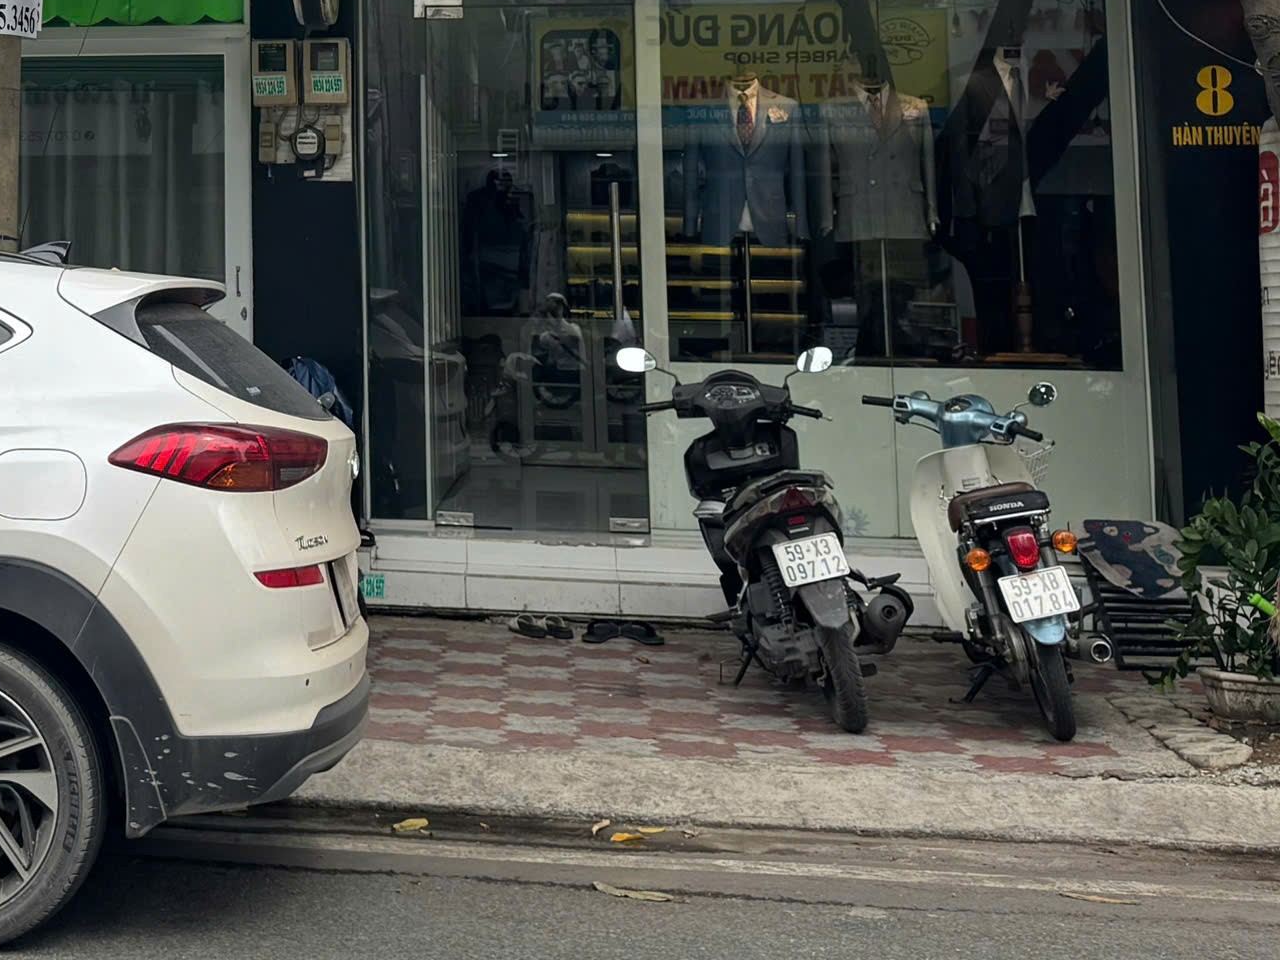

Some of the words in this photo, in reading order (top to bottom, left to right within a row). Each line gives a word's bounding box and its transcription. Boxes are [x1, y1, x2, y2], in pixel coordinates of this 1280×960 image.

[1195, 64, 1235, 116] 8
[1172, 122, 1203, 147] HÀN
[1205, 121, 1261, 147] THUYÊN
[989, 501, 1025, 512] HONDA
[784, 538, 831, 562] 59-X3
[786, 555, 845, 582] 097.12
[1010, 571, 1060, 598] 59-XB
[1011, 590, 1074, 619] 017.84
